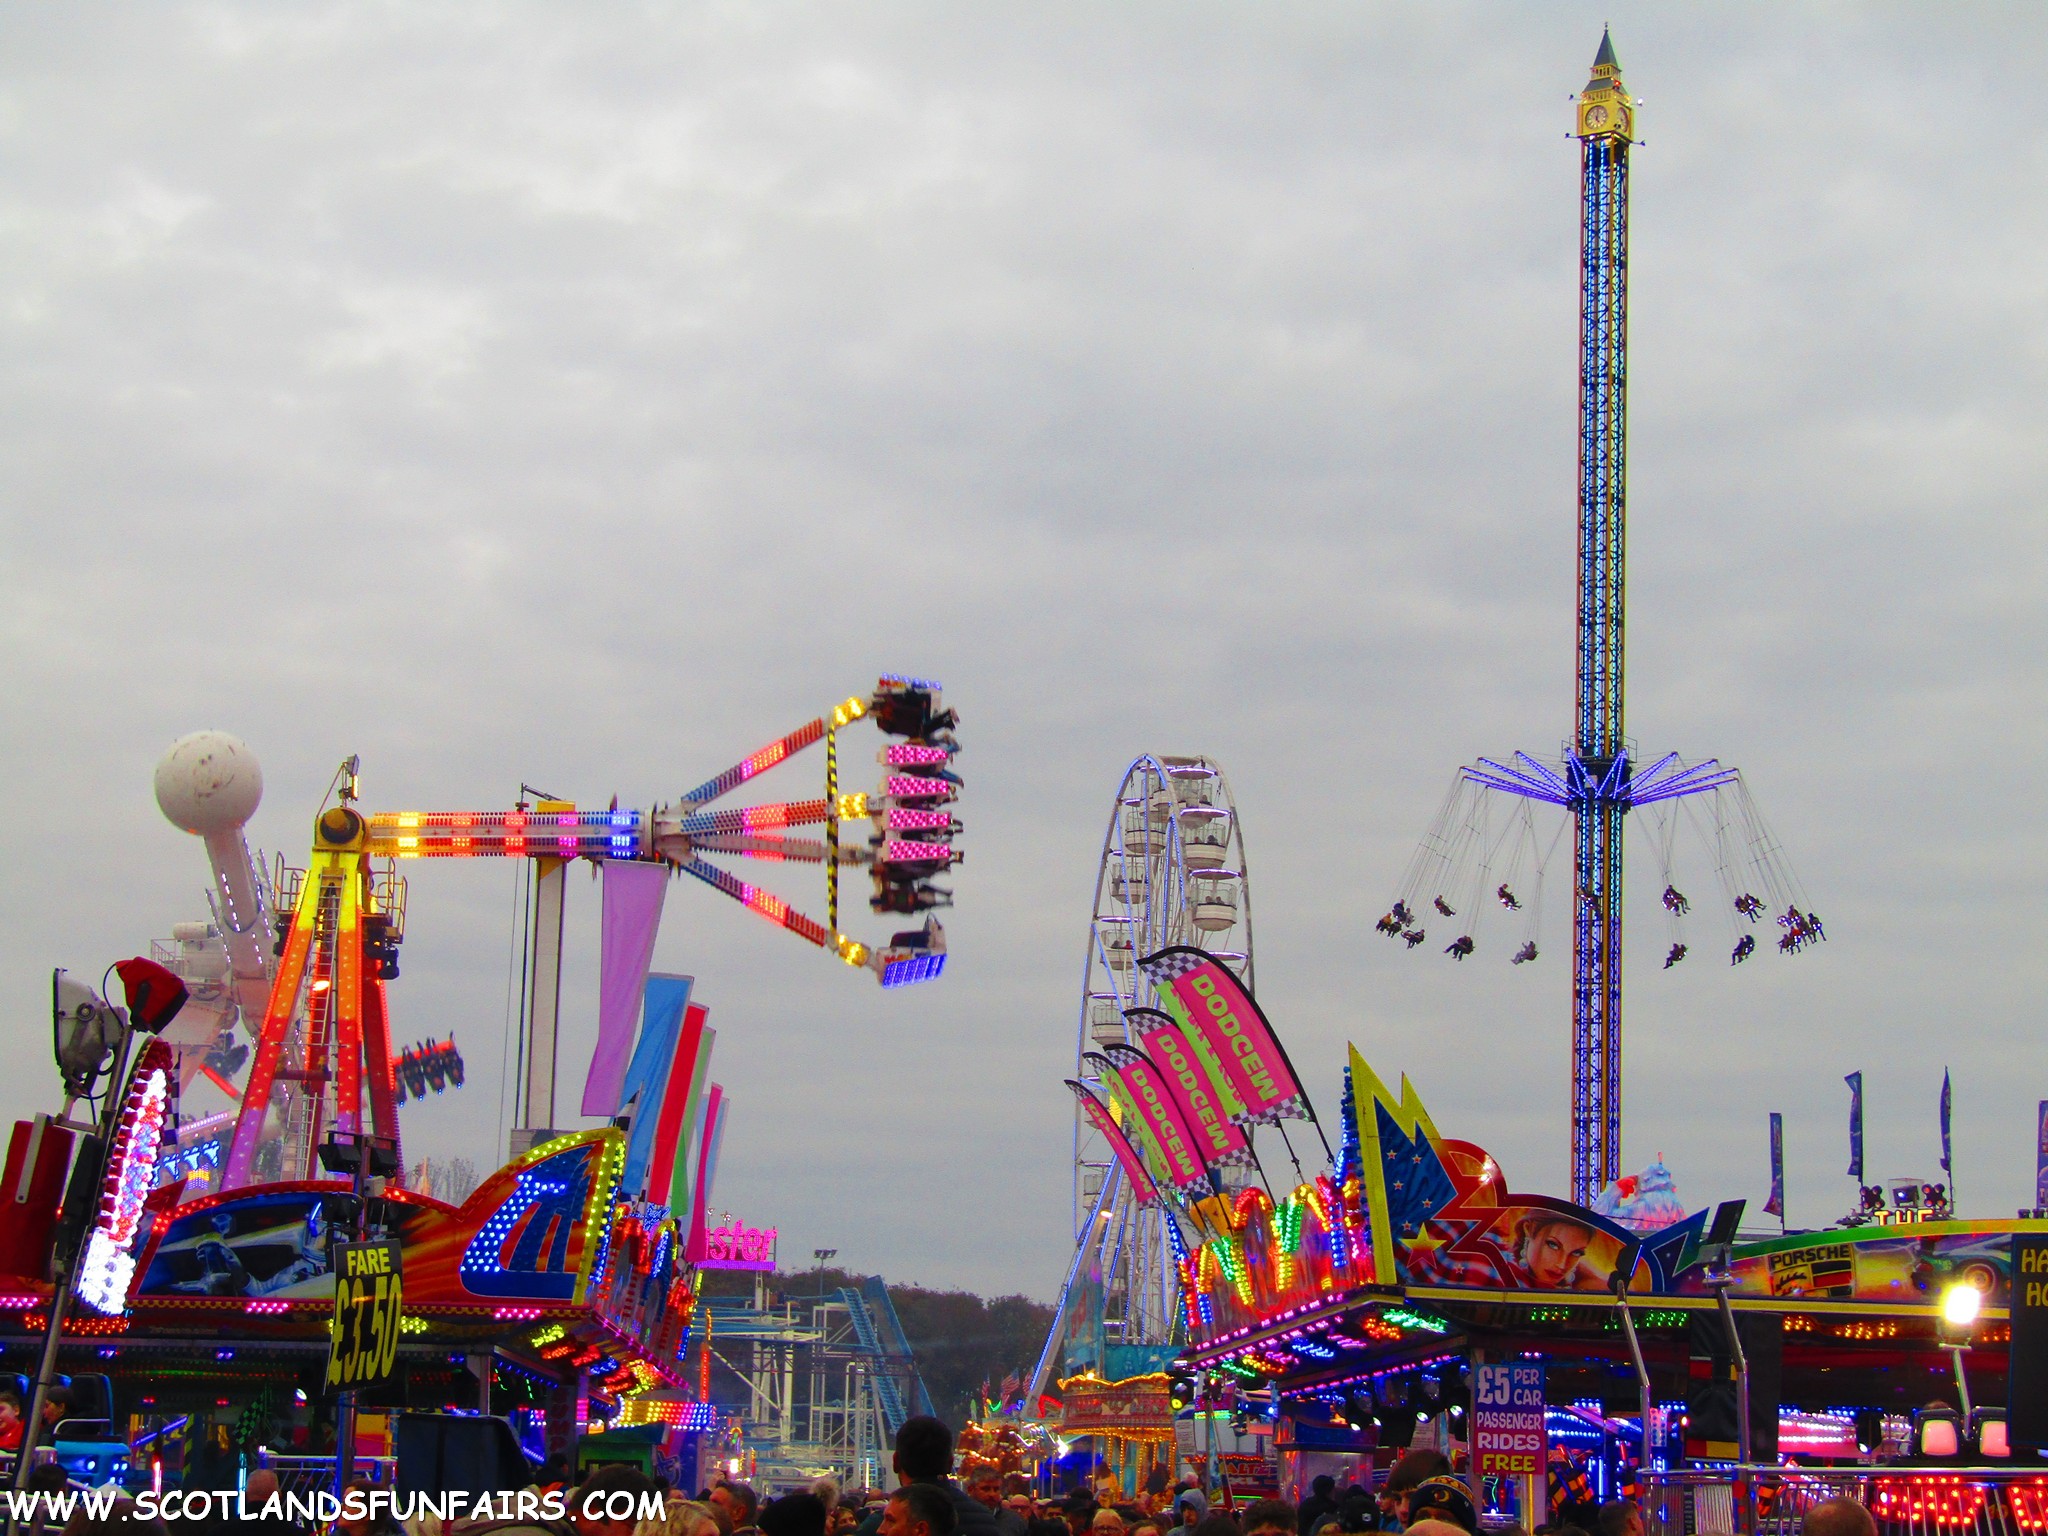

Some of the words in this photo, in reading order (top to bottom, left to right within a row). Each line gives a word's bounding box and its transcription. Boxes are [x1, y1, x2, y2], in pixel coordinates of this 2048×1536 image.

[346, 1247, 391, 1277] FARE
[1769, 1244, 1850, 1270] PORSCHE
[327, 1273, 402, 1386] £3.50
[1477, 1365, 1511, 1405] £5
[1514, 1368, 1540, 1385] PER
[1513, 1388, 1542, 1406] CAR
[1476, 1411, 1541, 1430] PASSENGER
[1477, 1432, 1541, 1451] RIDES
[1482, 1453, 1536, 1472] FREE
